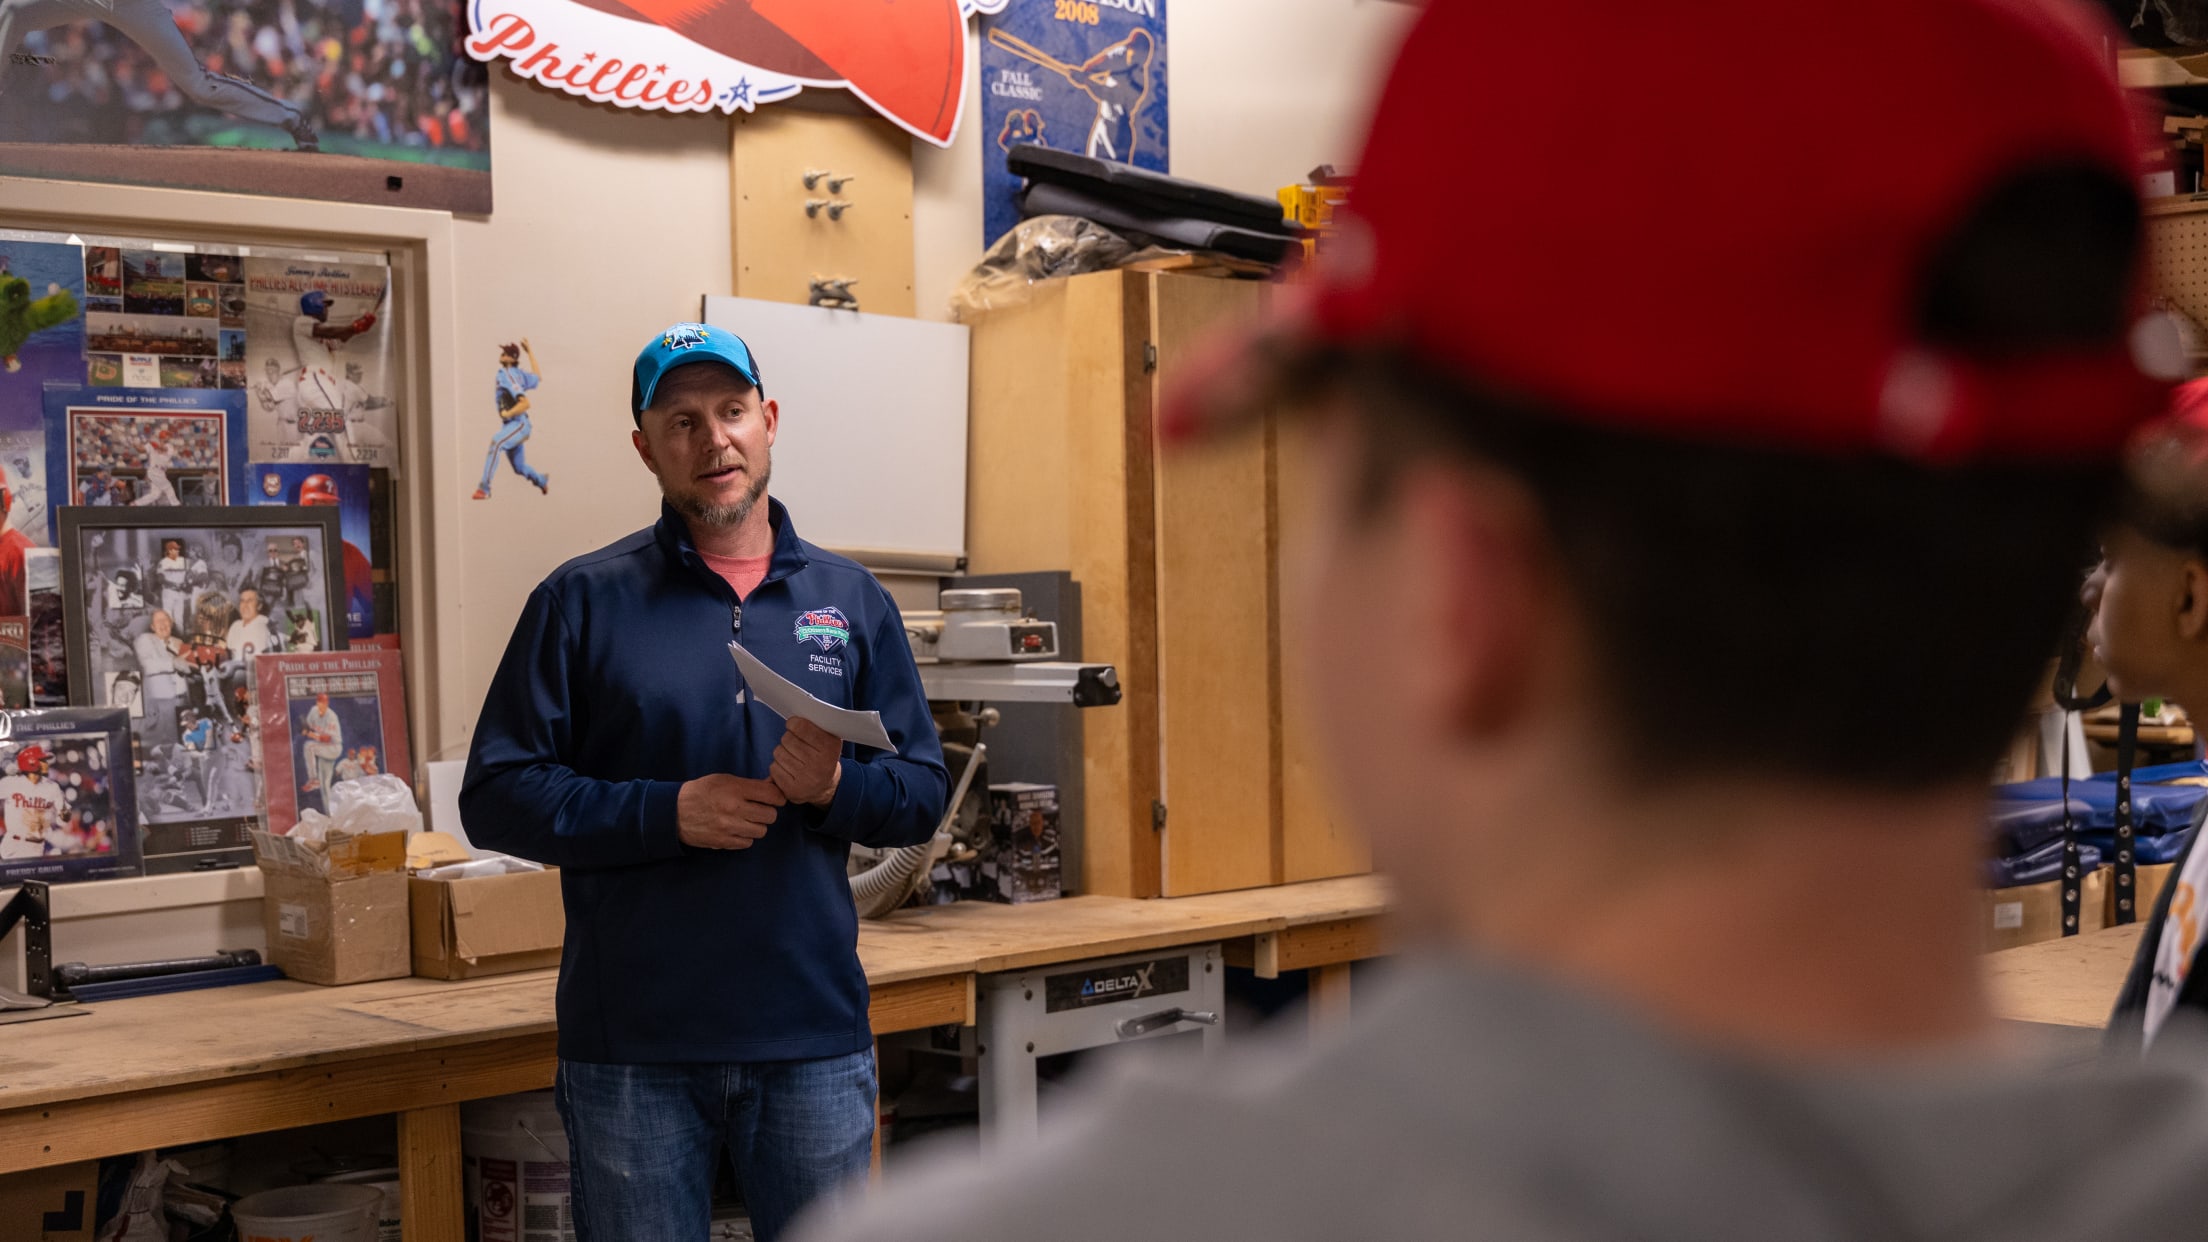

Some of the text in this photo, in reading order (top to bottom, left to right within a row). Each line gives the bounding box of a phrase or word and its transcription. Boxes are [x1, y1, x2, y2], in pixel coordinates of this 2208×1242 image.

[1055, 0, 1099, 26] 2008
[471, 13, 713, 106] Phillies
[1001, 69, 1033, 86] FALL
[991, 80, 1044, 102] CLASSIC
[126, 396, 139, 404] OF
[141, 396, 158, 405] THE
[159, 397, 198, 406] PHILLIES
[298, 408, 345, 435] 2,235
[806, 613, 844, 628] Phillies
[278, 660, 306, 673] PRIDE
[323, 661, 340, 671] THE
[810, 654, 841, 666] FACILITY
[808, 663, 843, 676] SERVICES
[15, 721, 76, 732] THE PHILLIES
